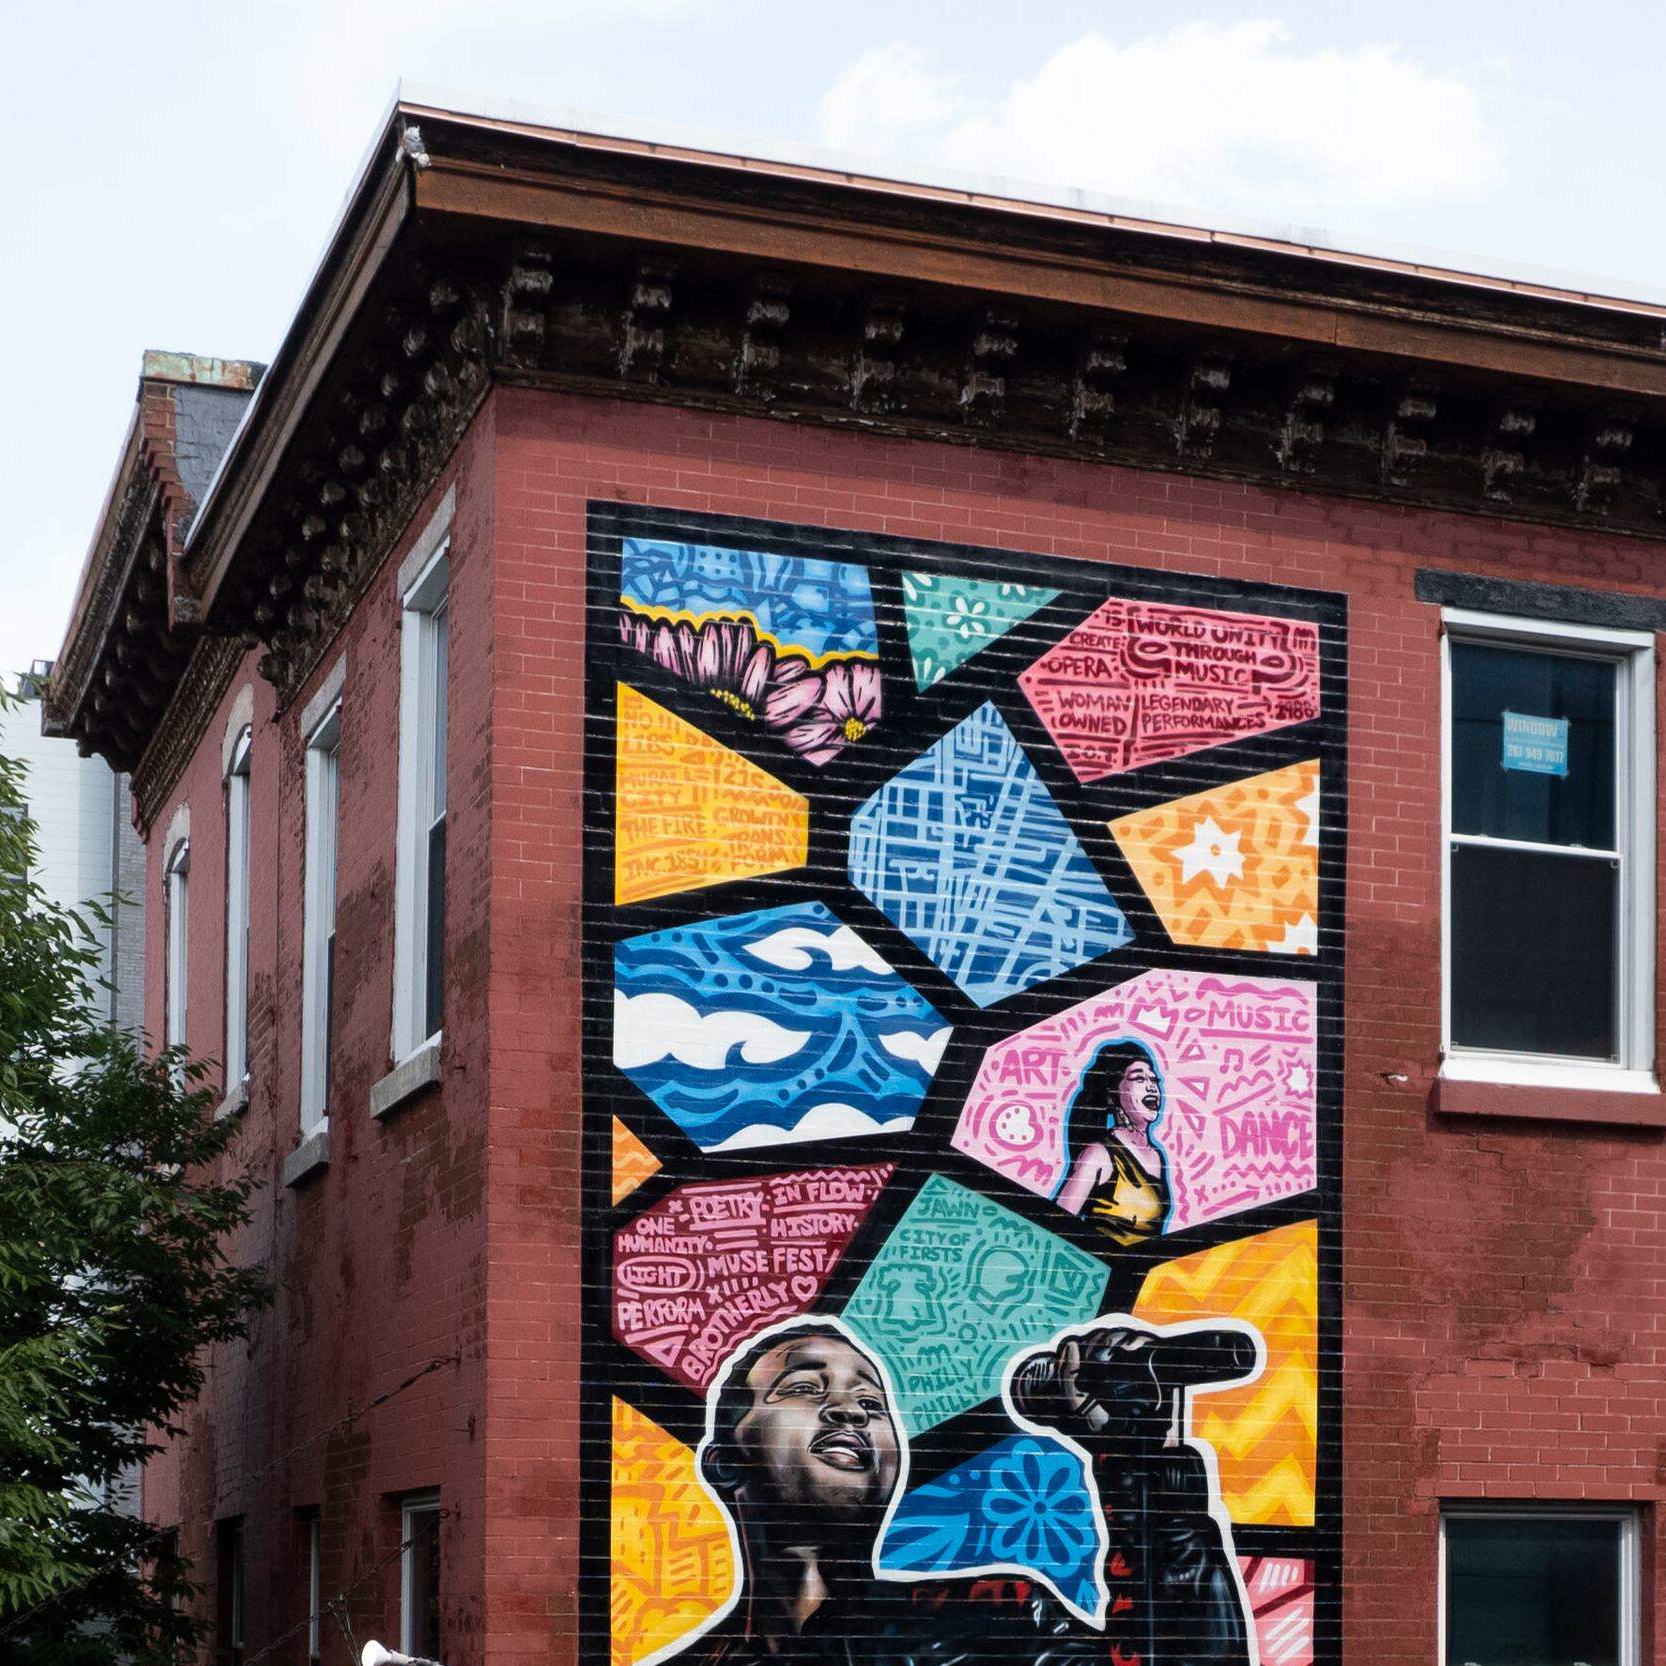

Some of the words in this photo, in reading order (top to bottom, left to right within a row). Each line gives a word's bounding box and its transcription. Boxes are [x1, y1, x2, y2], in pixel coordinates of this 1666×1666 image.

[1069, 632, 1120, 649] CREATE
[1137, 617, 1205, 639] WORLD
[1210, 625, 1279, 649] UNITY
[1173, 642, 1256, 665] THROUGH
[1047, 656, 1112, 678] OPERA
[1175, 661, 1247, 685] MUSIC
[1057, 690, 1131, 712] WOMAN
[1141, 694, 1233, 715] LEGENDARY
[1059, 713, 1127, 736] OWNED
[1142, 712, 1265, 733] PERFORMANCES
[662, 813, 708, 836] FIRE
[1209, 1000, 1309, 1032] MUSIC
[1000, 1049, 1066, 1086] ART
[1220, 1111, 1313, 1160] DANCE
[773, 1185, 802, 1204] IN
[808, 1181, 865, 1202] FLOW
[690, 1192, 765, 1222] POETRY
[917, 1199, 979, 1218] JAWN
[636, 1217, 675, 1236] ONE
[771, 1213, 855, 1238] HISTORY
[899, 1229, 947, 1246] CITY
[950, 1232, 971, 1246] OF
[708, 1251, 769, 1278] MUSE
[773, 1248, 826, 1274] FEST
[899, 1246, 963, 1262] FIRSTS
[626, 1266, 683, 1286] LIGHT
[618, 1295, 706, 1331] PERFORM
[682, 1280, 790, 1382] BROTHERLY
[908, 1358, 974, 1392] PHILLY
[912, 1382, 980, 1431] PHILLY
